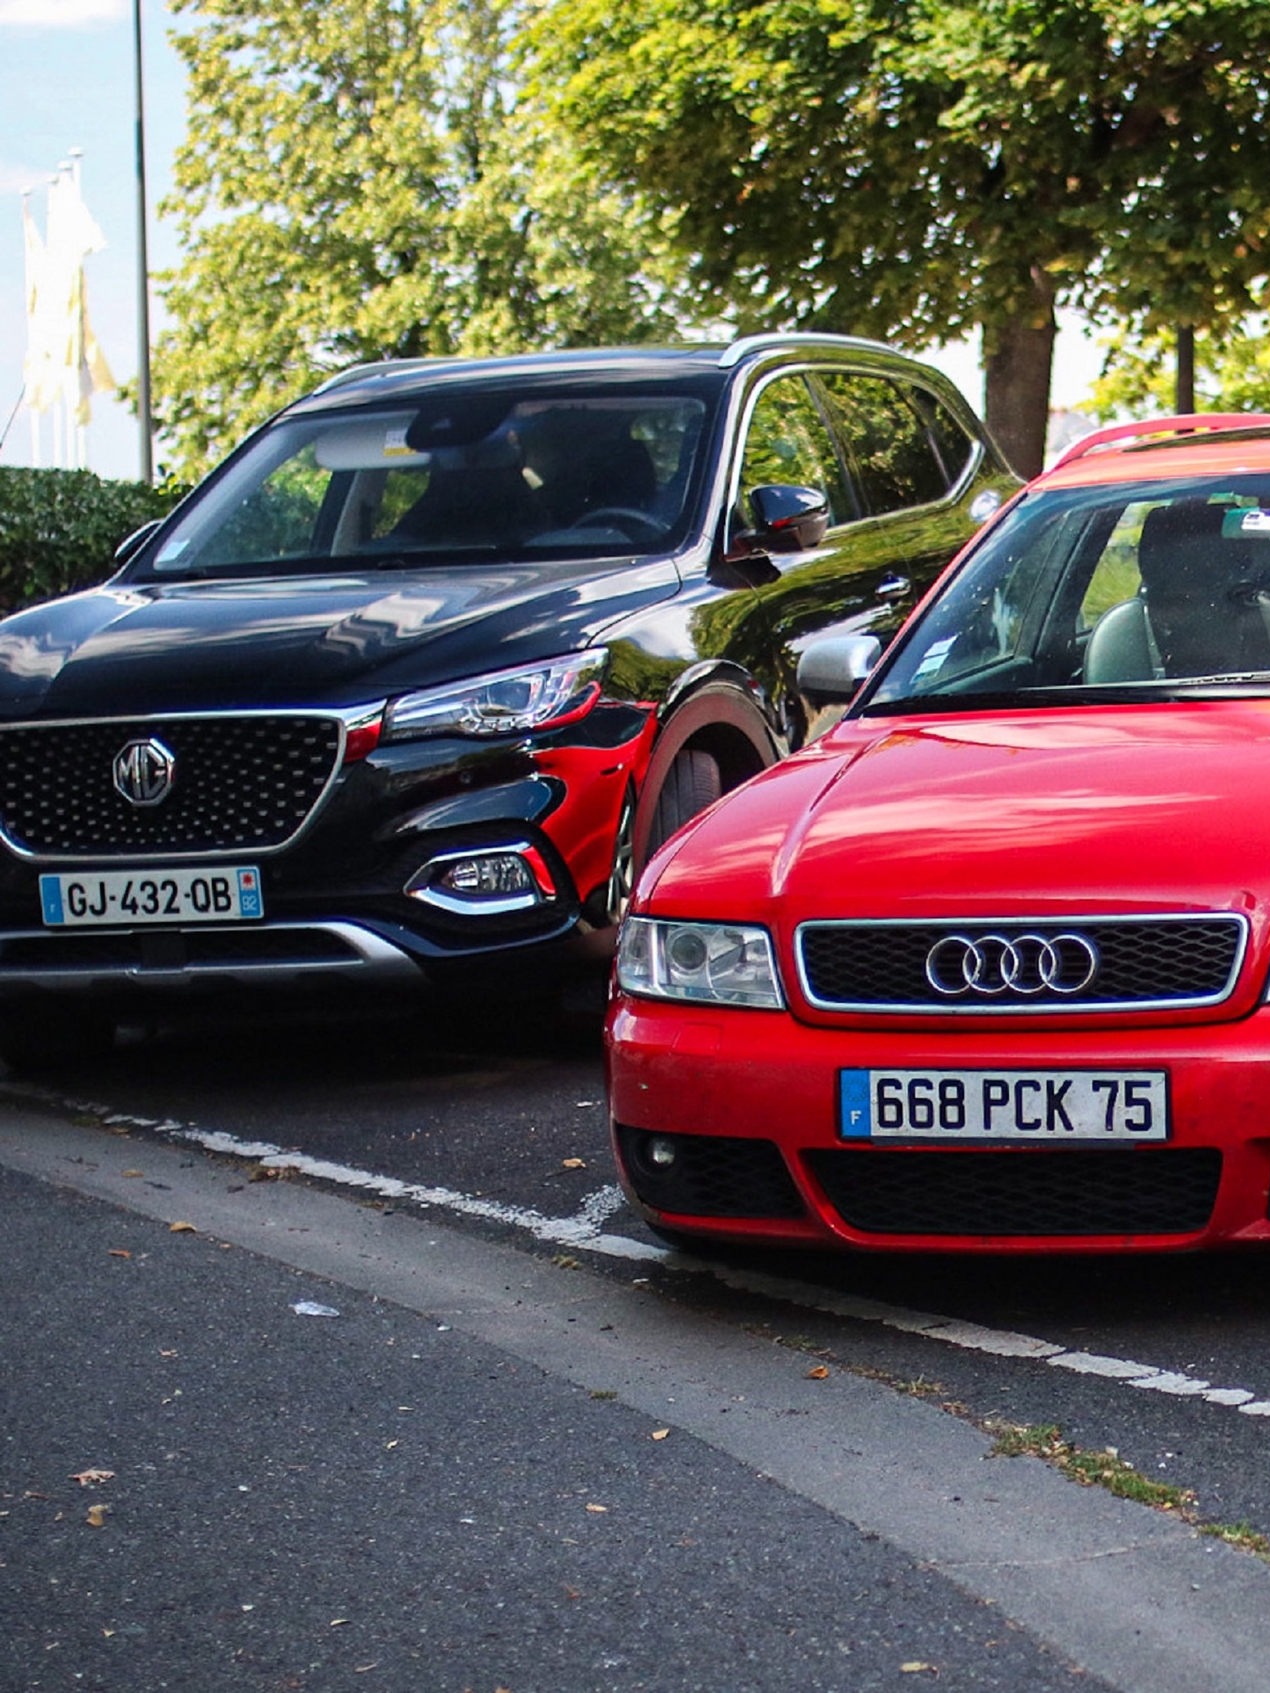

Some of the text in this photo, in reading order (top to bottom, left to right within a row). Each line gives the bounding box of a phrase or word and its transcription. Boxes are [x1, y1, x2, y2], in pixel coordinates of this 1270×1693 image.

[118, 745, 166, 799] MG
[67, 877, 232, 917] GJ-432-QB
[242, 895, 258, 911] 92
[851, 1111, 862, 1125] F
[876, 1078, 1153, 1131] 668 PCK 75
